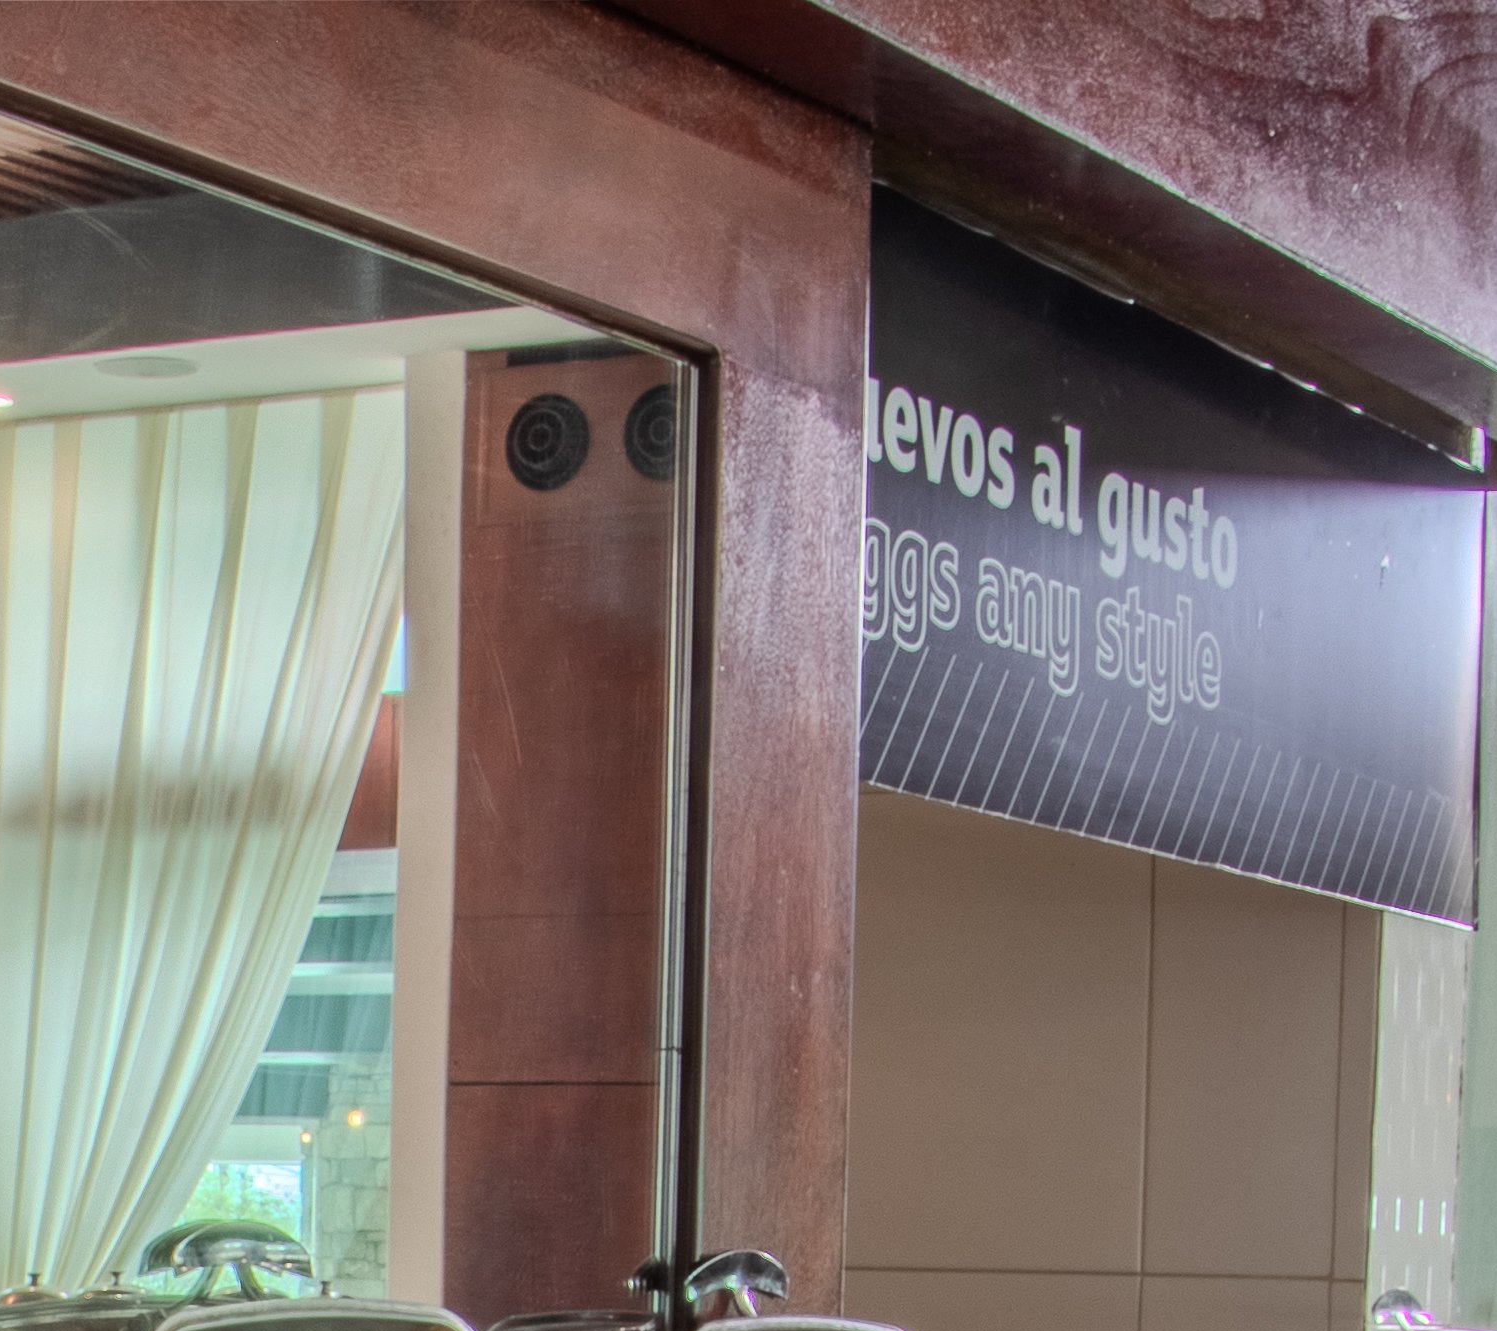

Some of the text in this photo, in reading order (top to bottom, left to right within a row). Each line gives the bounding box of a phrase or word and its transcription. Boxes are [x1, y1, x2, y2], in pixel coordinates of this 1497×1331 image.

[1031, 424, 1083, 536] al
[1098, 472, 1237, 589] gusto
[975, 557, 1081, 697] any
[1095, 585, 1222, 725] style
